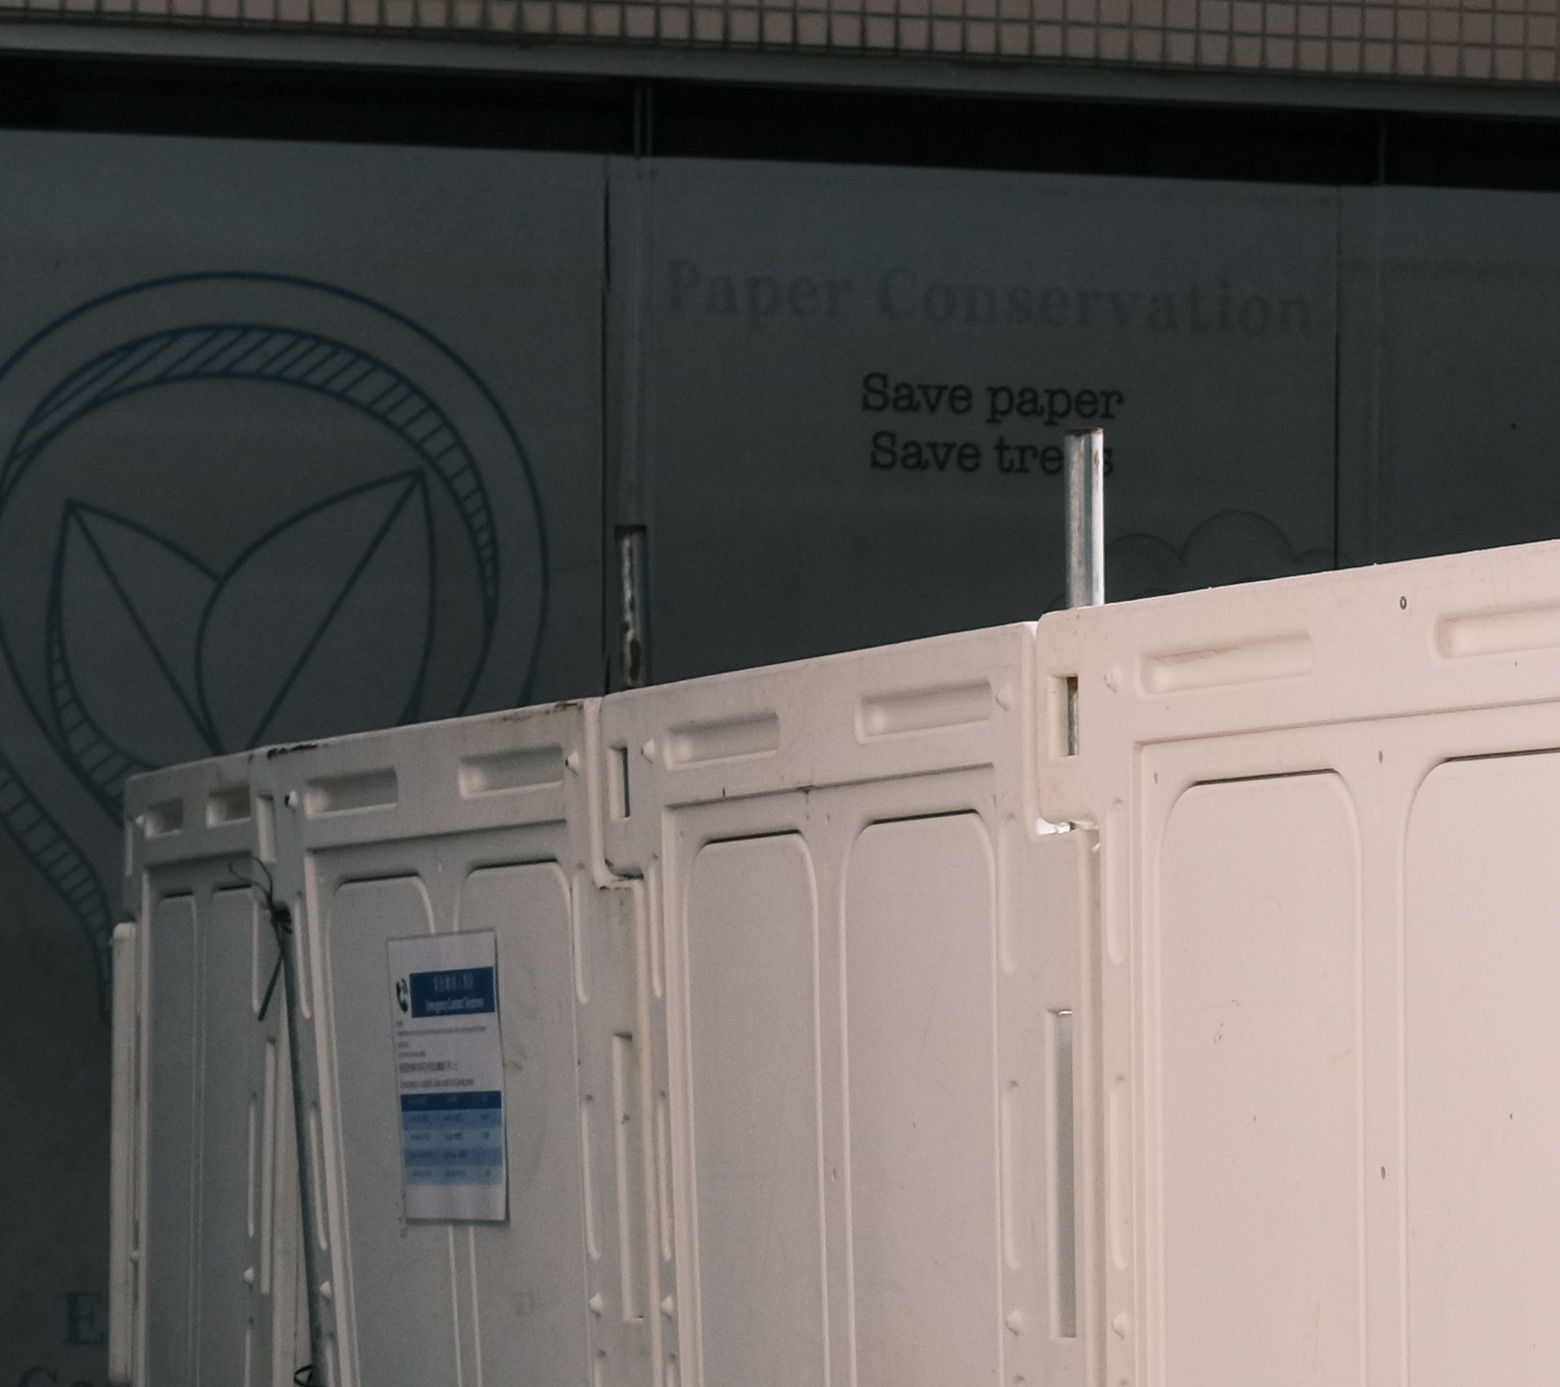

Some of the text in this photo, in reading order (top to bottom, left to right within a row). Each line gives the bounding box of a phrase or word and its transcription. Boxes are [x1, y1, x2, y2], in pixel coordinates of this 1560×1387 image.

[664, 257, 1313, 338] Paper Conservation
[861, 371, 1125, 427] Save paper
[870, 429, 1114, 477] Save tres
